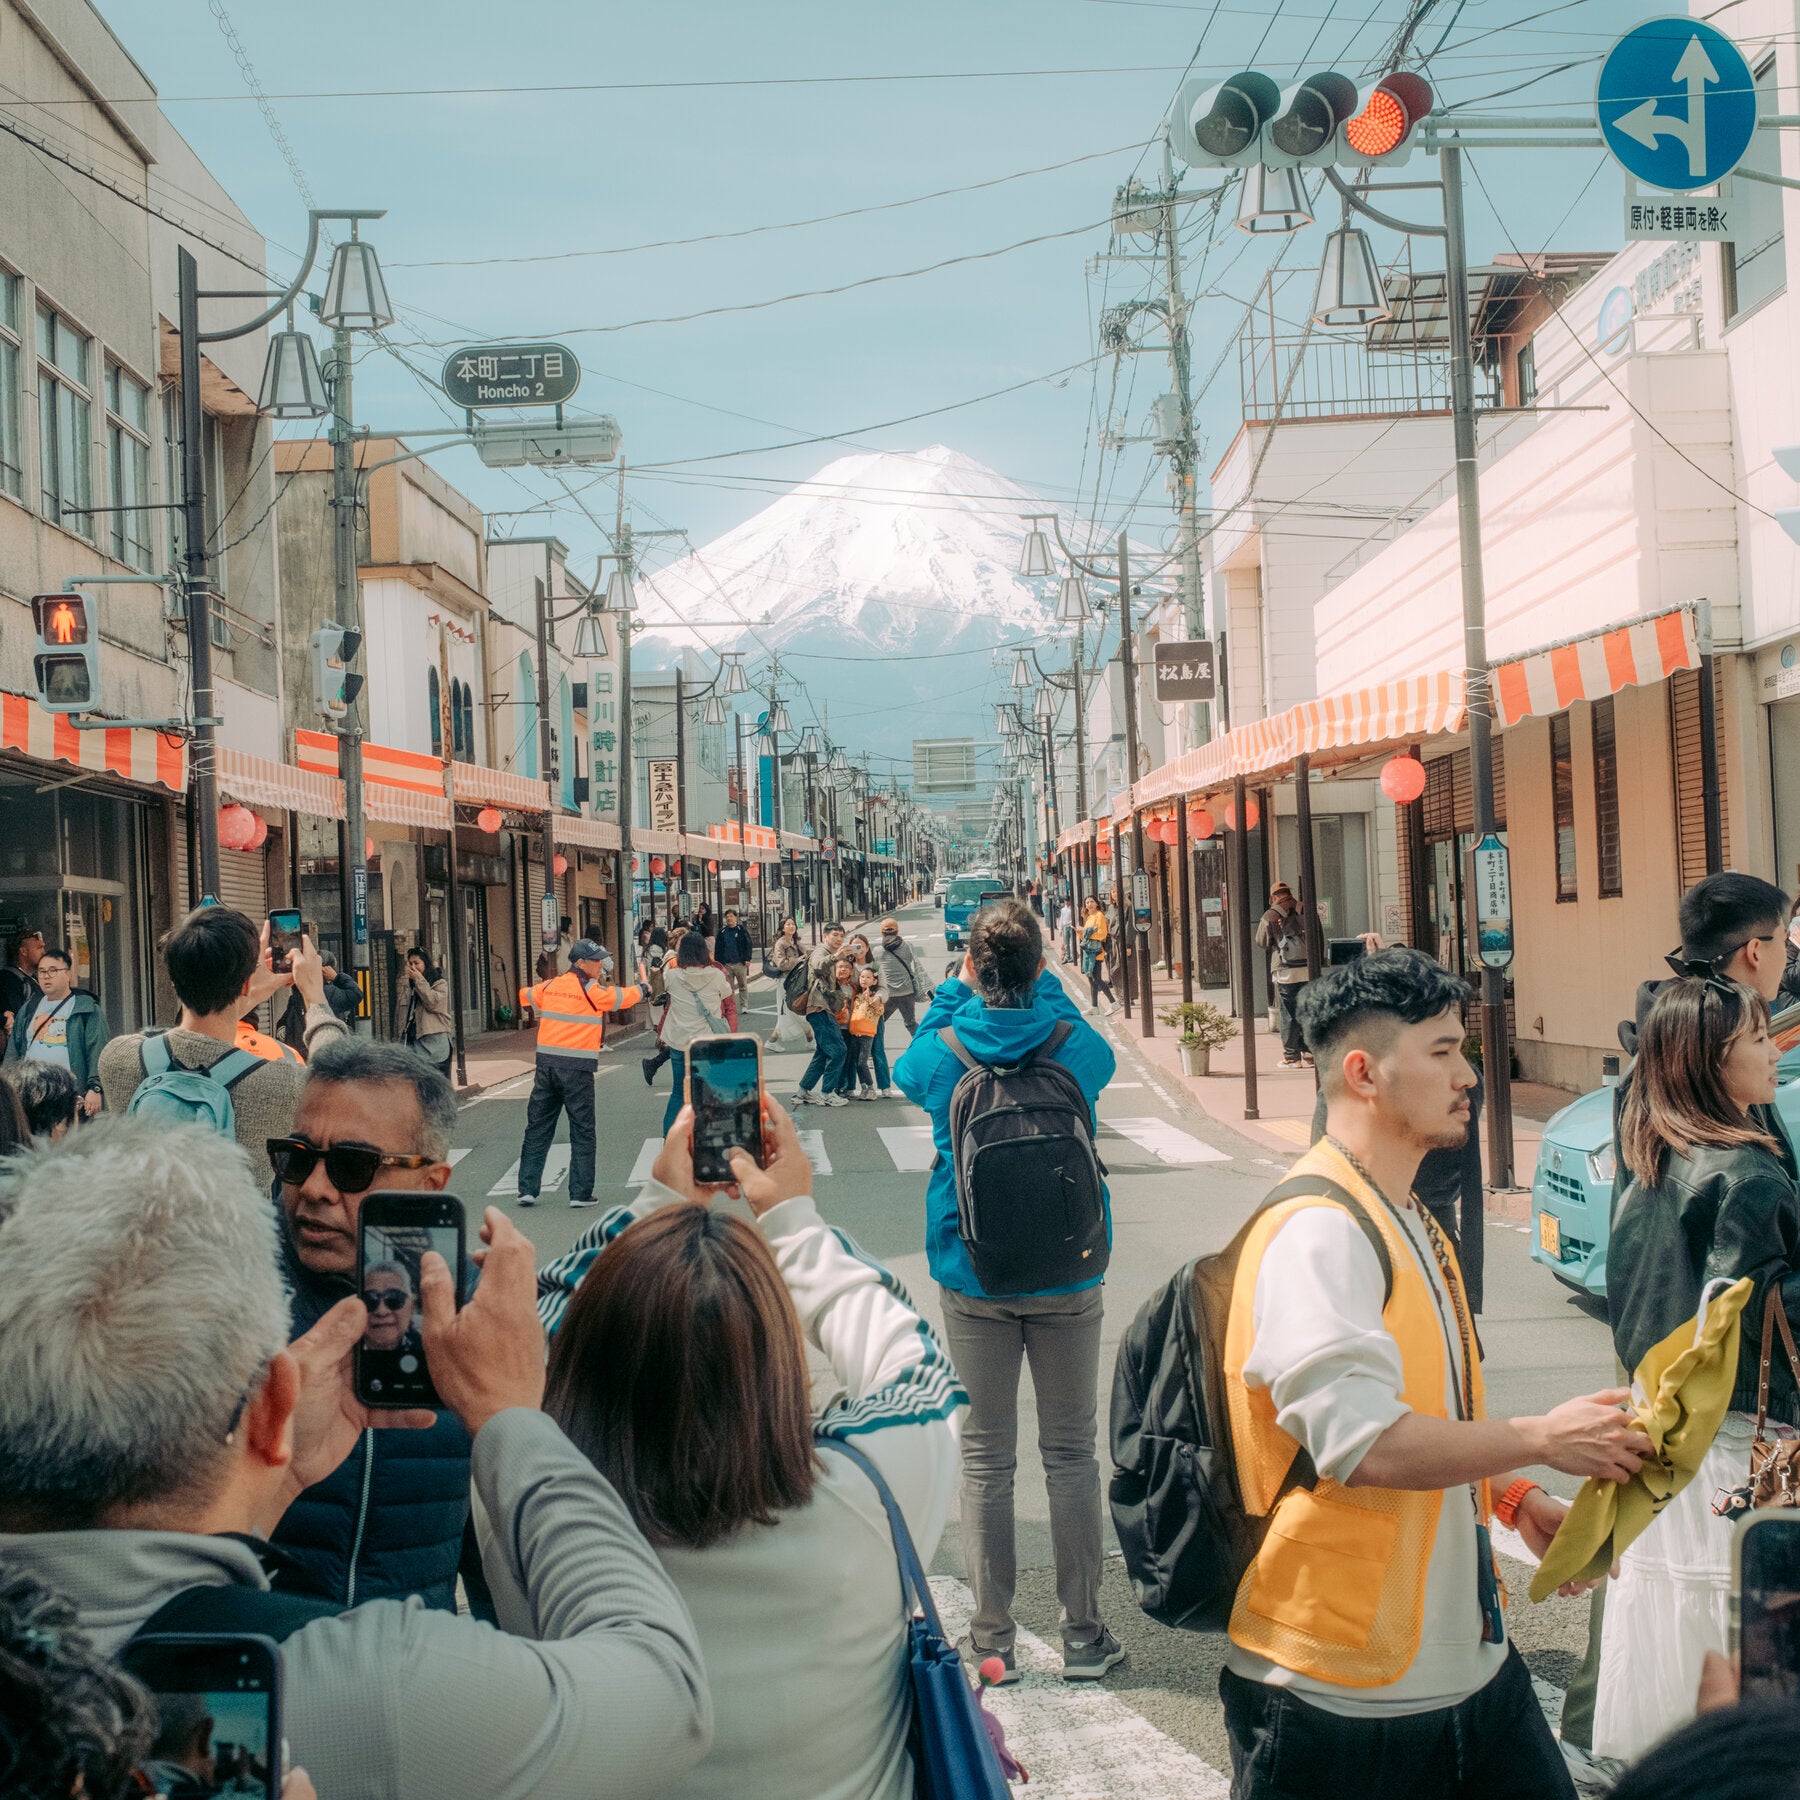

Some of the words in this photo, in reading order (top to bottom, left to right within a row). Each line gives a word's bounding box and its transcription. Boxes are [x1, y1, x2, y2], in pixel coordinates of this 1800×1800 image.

[1631, 205, 1728, 232] 原付・軽車両を除く
[457, 353, 563, 382] 本町二丁目
[478, 384, 530, 399] Honcho
[535, 382, 545, 396] 2
[1159, 662, 1212, 680] 松島屋
[593, 671, 617, 812] 日川時計店
[653, 763, 675, 832] 富士急ハイラン
[1487, 851, 1498, 916] 本町二丁目商店街
